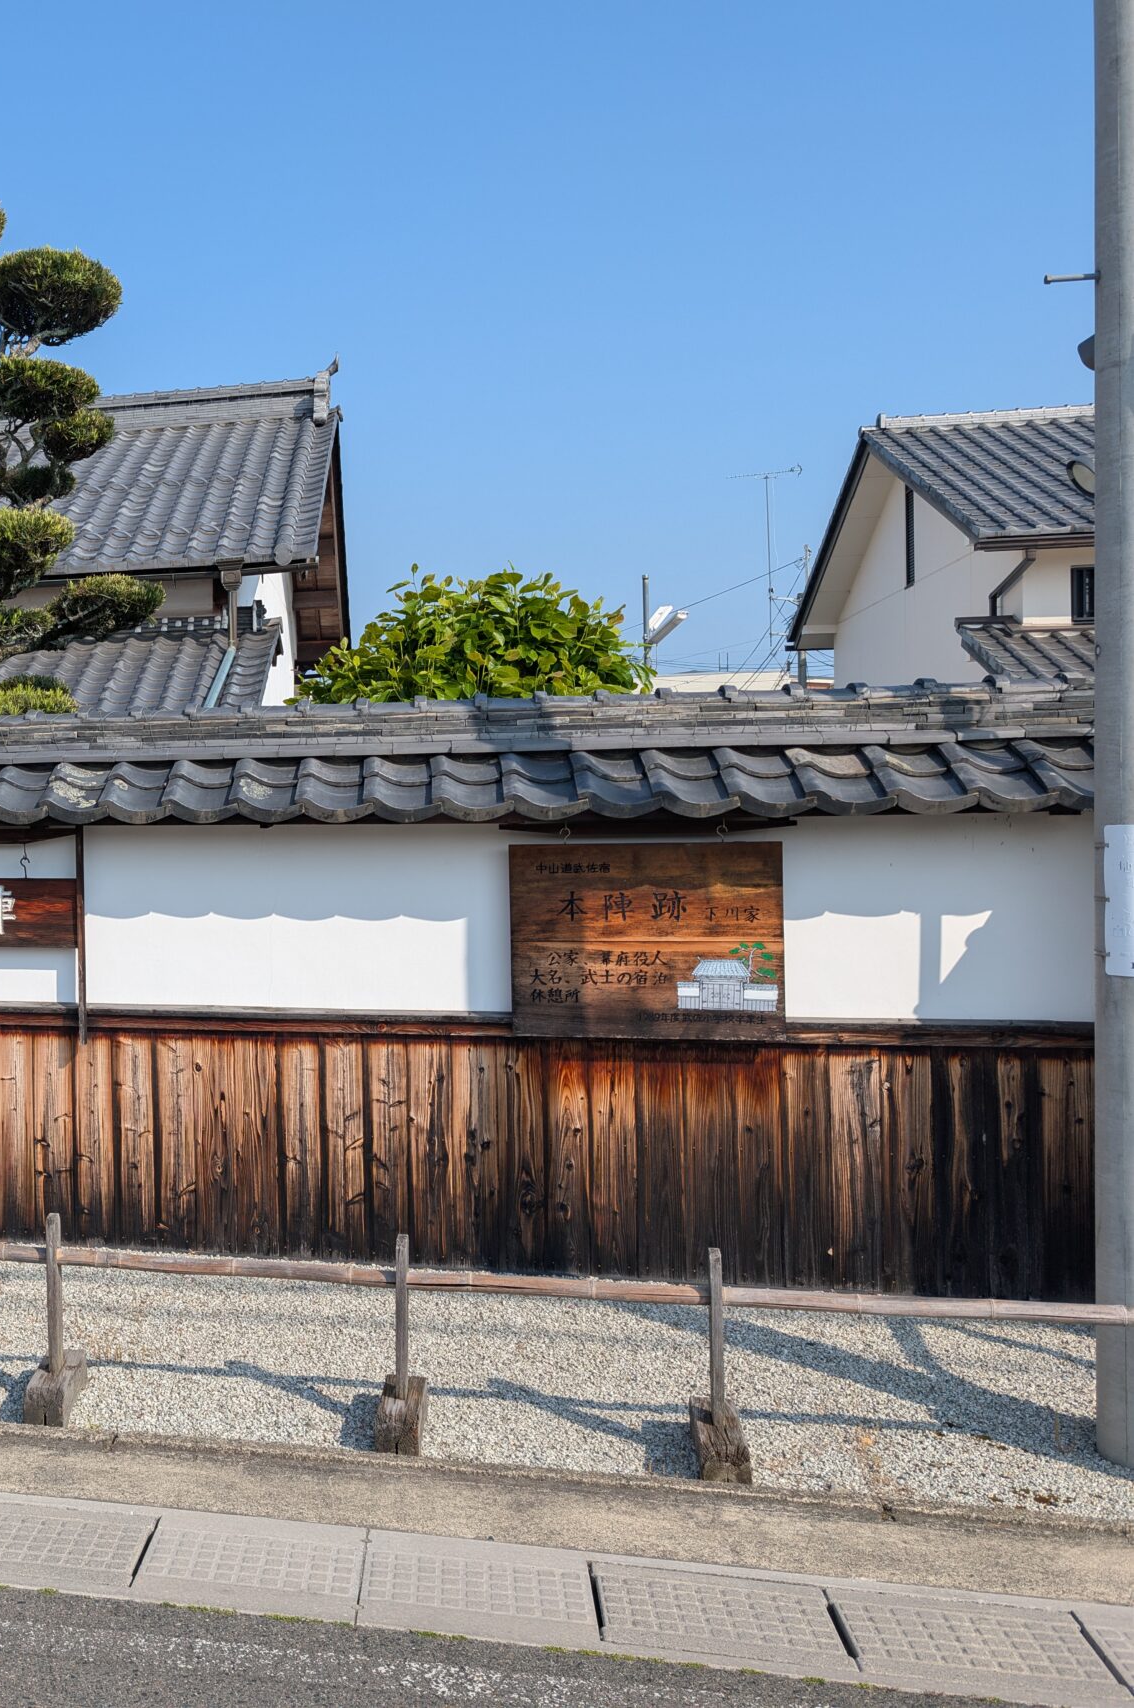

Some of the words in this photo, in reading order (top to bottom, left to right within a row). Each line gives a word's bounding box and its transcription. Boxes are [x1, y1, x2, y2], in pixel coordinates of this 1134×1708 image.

[556, 890, 688, 922] 本陣跡
[705, 905, 761, 922] 下川家
[548, 949, 668, 967] 公家、幕府役人
[530, 968, 668, 985] 大名、武士の宿泊
[530, 987, 581, 1003] 休憩所
